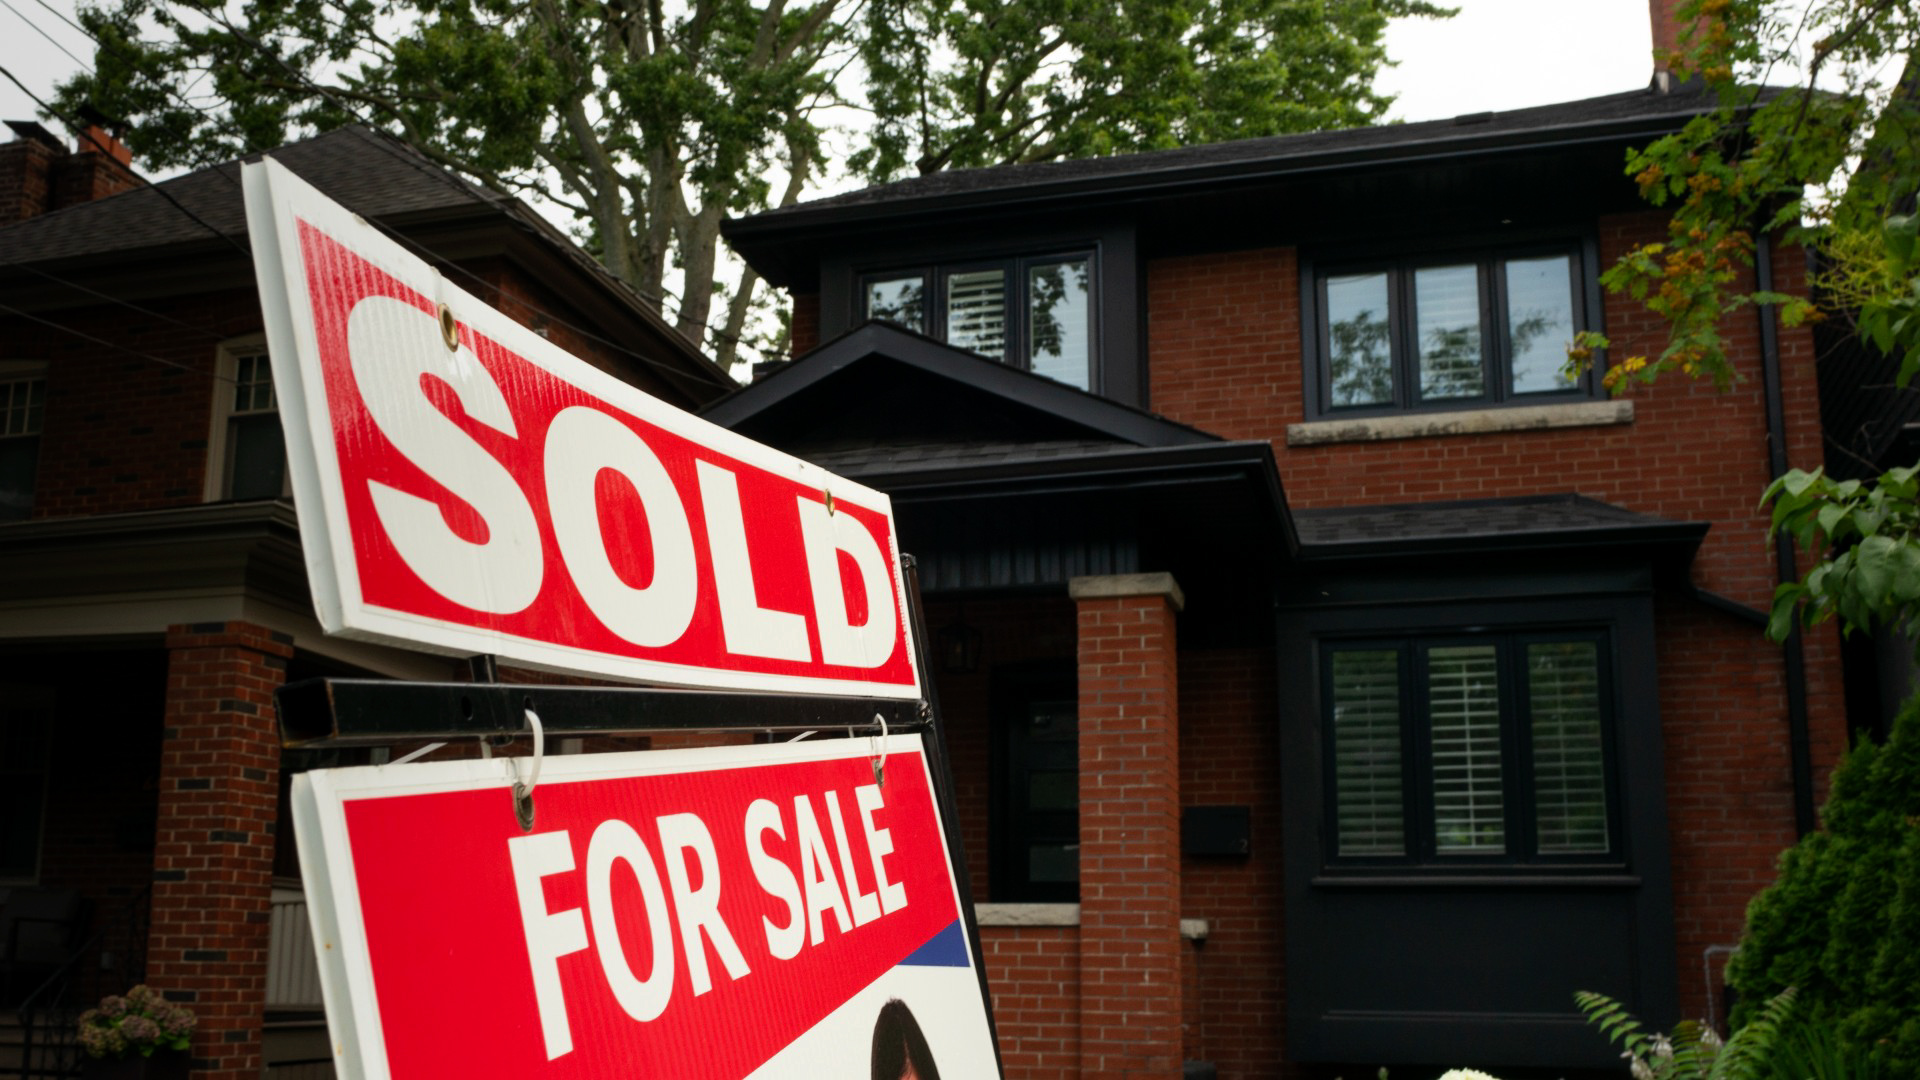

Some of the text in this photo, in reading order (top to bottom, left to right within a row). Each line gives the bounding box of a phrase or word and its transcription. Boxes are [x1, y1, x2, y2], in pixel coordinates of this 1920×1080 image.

[347, 294, 898, 669] SOLD
[508, 783, 909, 1061] FOR SALE
